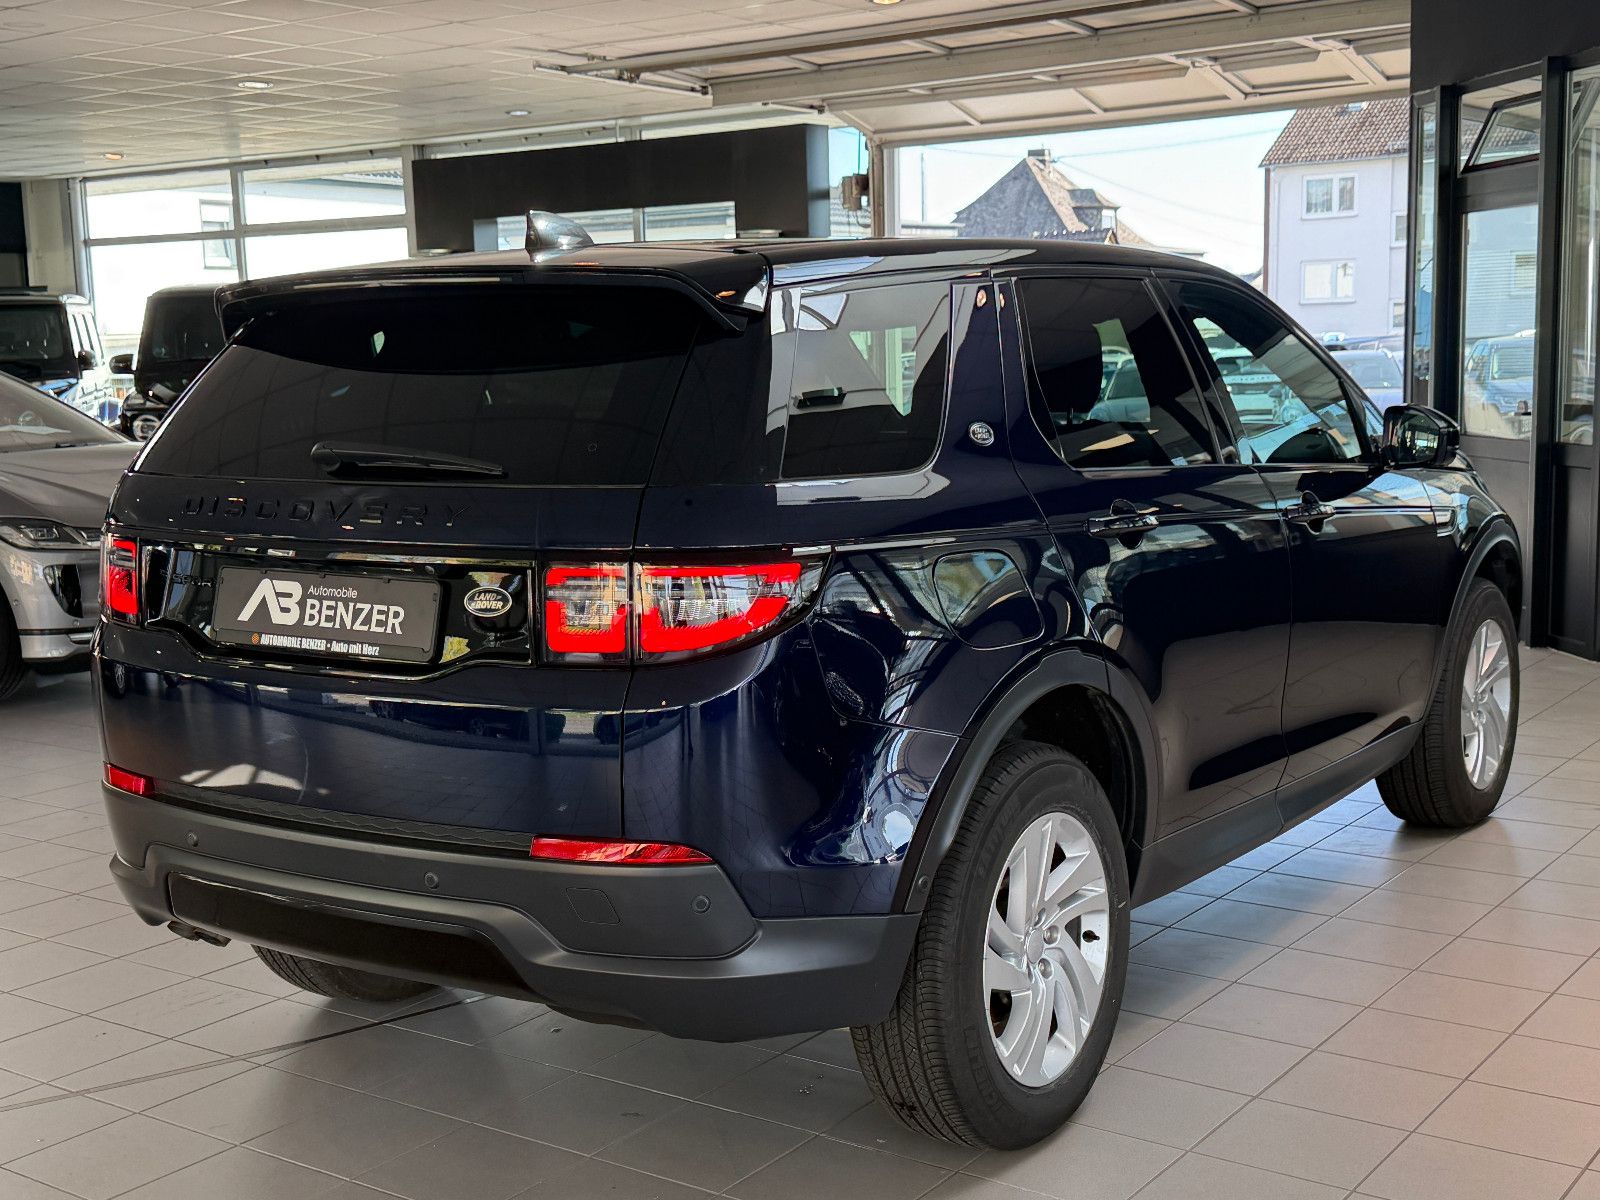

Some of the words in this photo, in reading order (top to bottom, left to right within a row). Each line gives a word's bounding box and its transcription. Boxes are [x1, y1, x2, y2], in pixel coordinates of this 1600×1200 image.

[307, 585, 358, 598] Automobile
[474, 592, 497, 600] LAND
[475, 601, 503, 609] ROVER
[302, 598, 405, 635] BENZER
[260, 633, 301, 648] AUTOMOBILE
[301, 637, 326, 650] BENZER
[331, 640, 348, 653] Auto
[348, 643, 362, 654] mit
[362, 644, 380, 656] Herz
